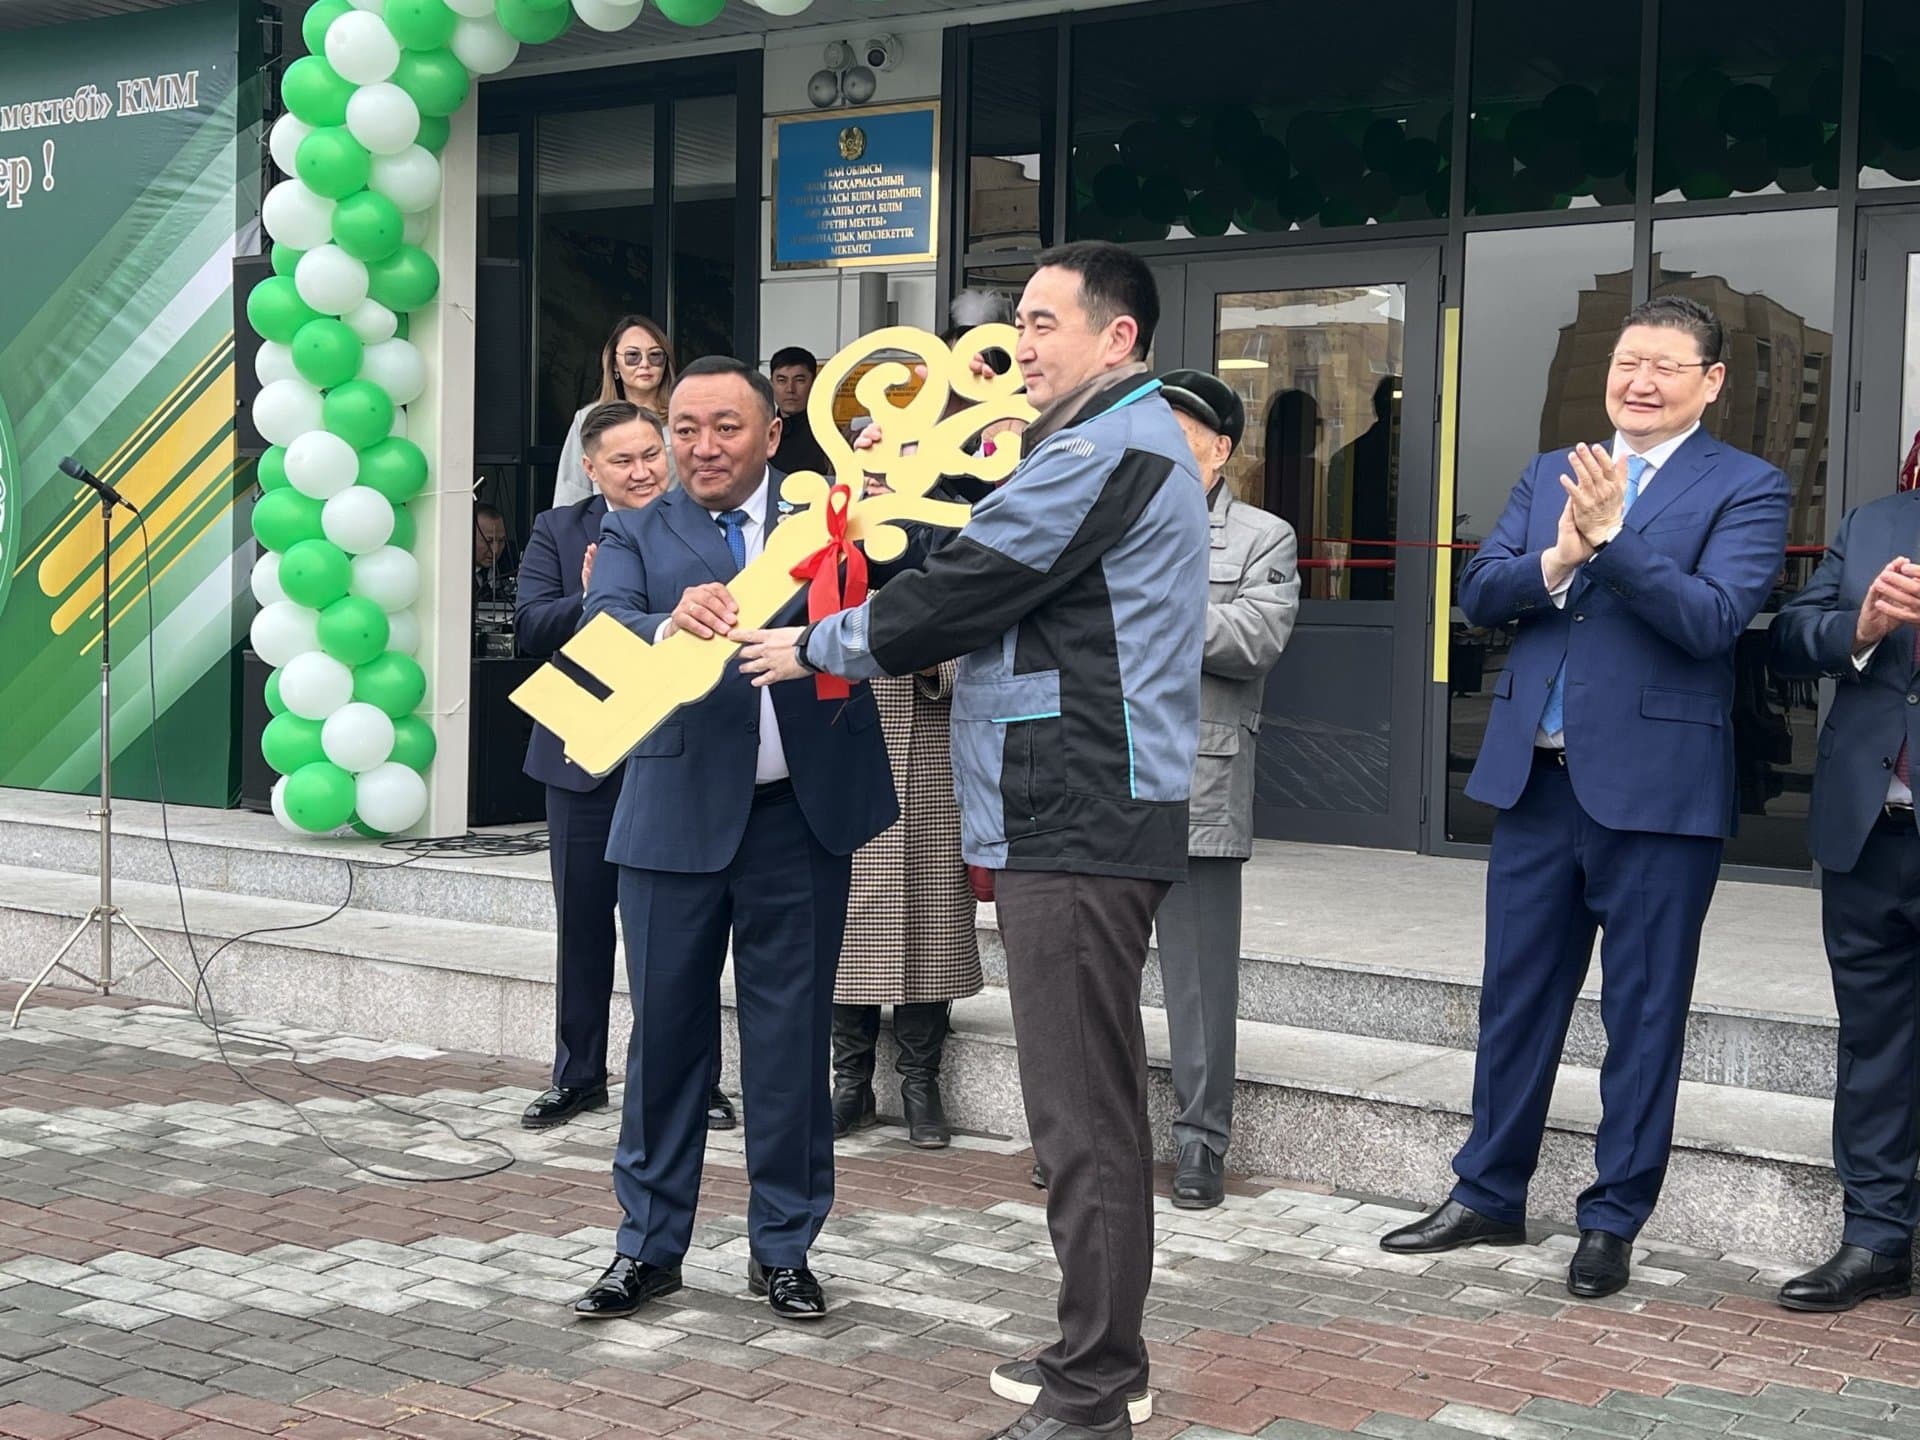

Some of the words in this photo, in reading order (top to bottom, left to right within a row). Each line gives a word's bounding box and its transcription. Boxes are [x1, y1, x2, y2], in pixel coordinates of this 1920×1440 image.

[0, 84, 113, 132] мектебі»
[116, 70, 199, 117] КММ
[42, 138, 55, 191] !
[851, 190, 875, 201] БІЛІМ
[855, 203, 877, 214] ОРТА
[878, 202, 903, 212] БІЛІМ
[857, 227, 914, 241] МЕМЛЕКЕТТІК
[830, 243, 872, 255] МЕКЕМЕСІ
